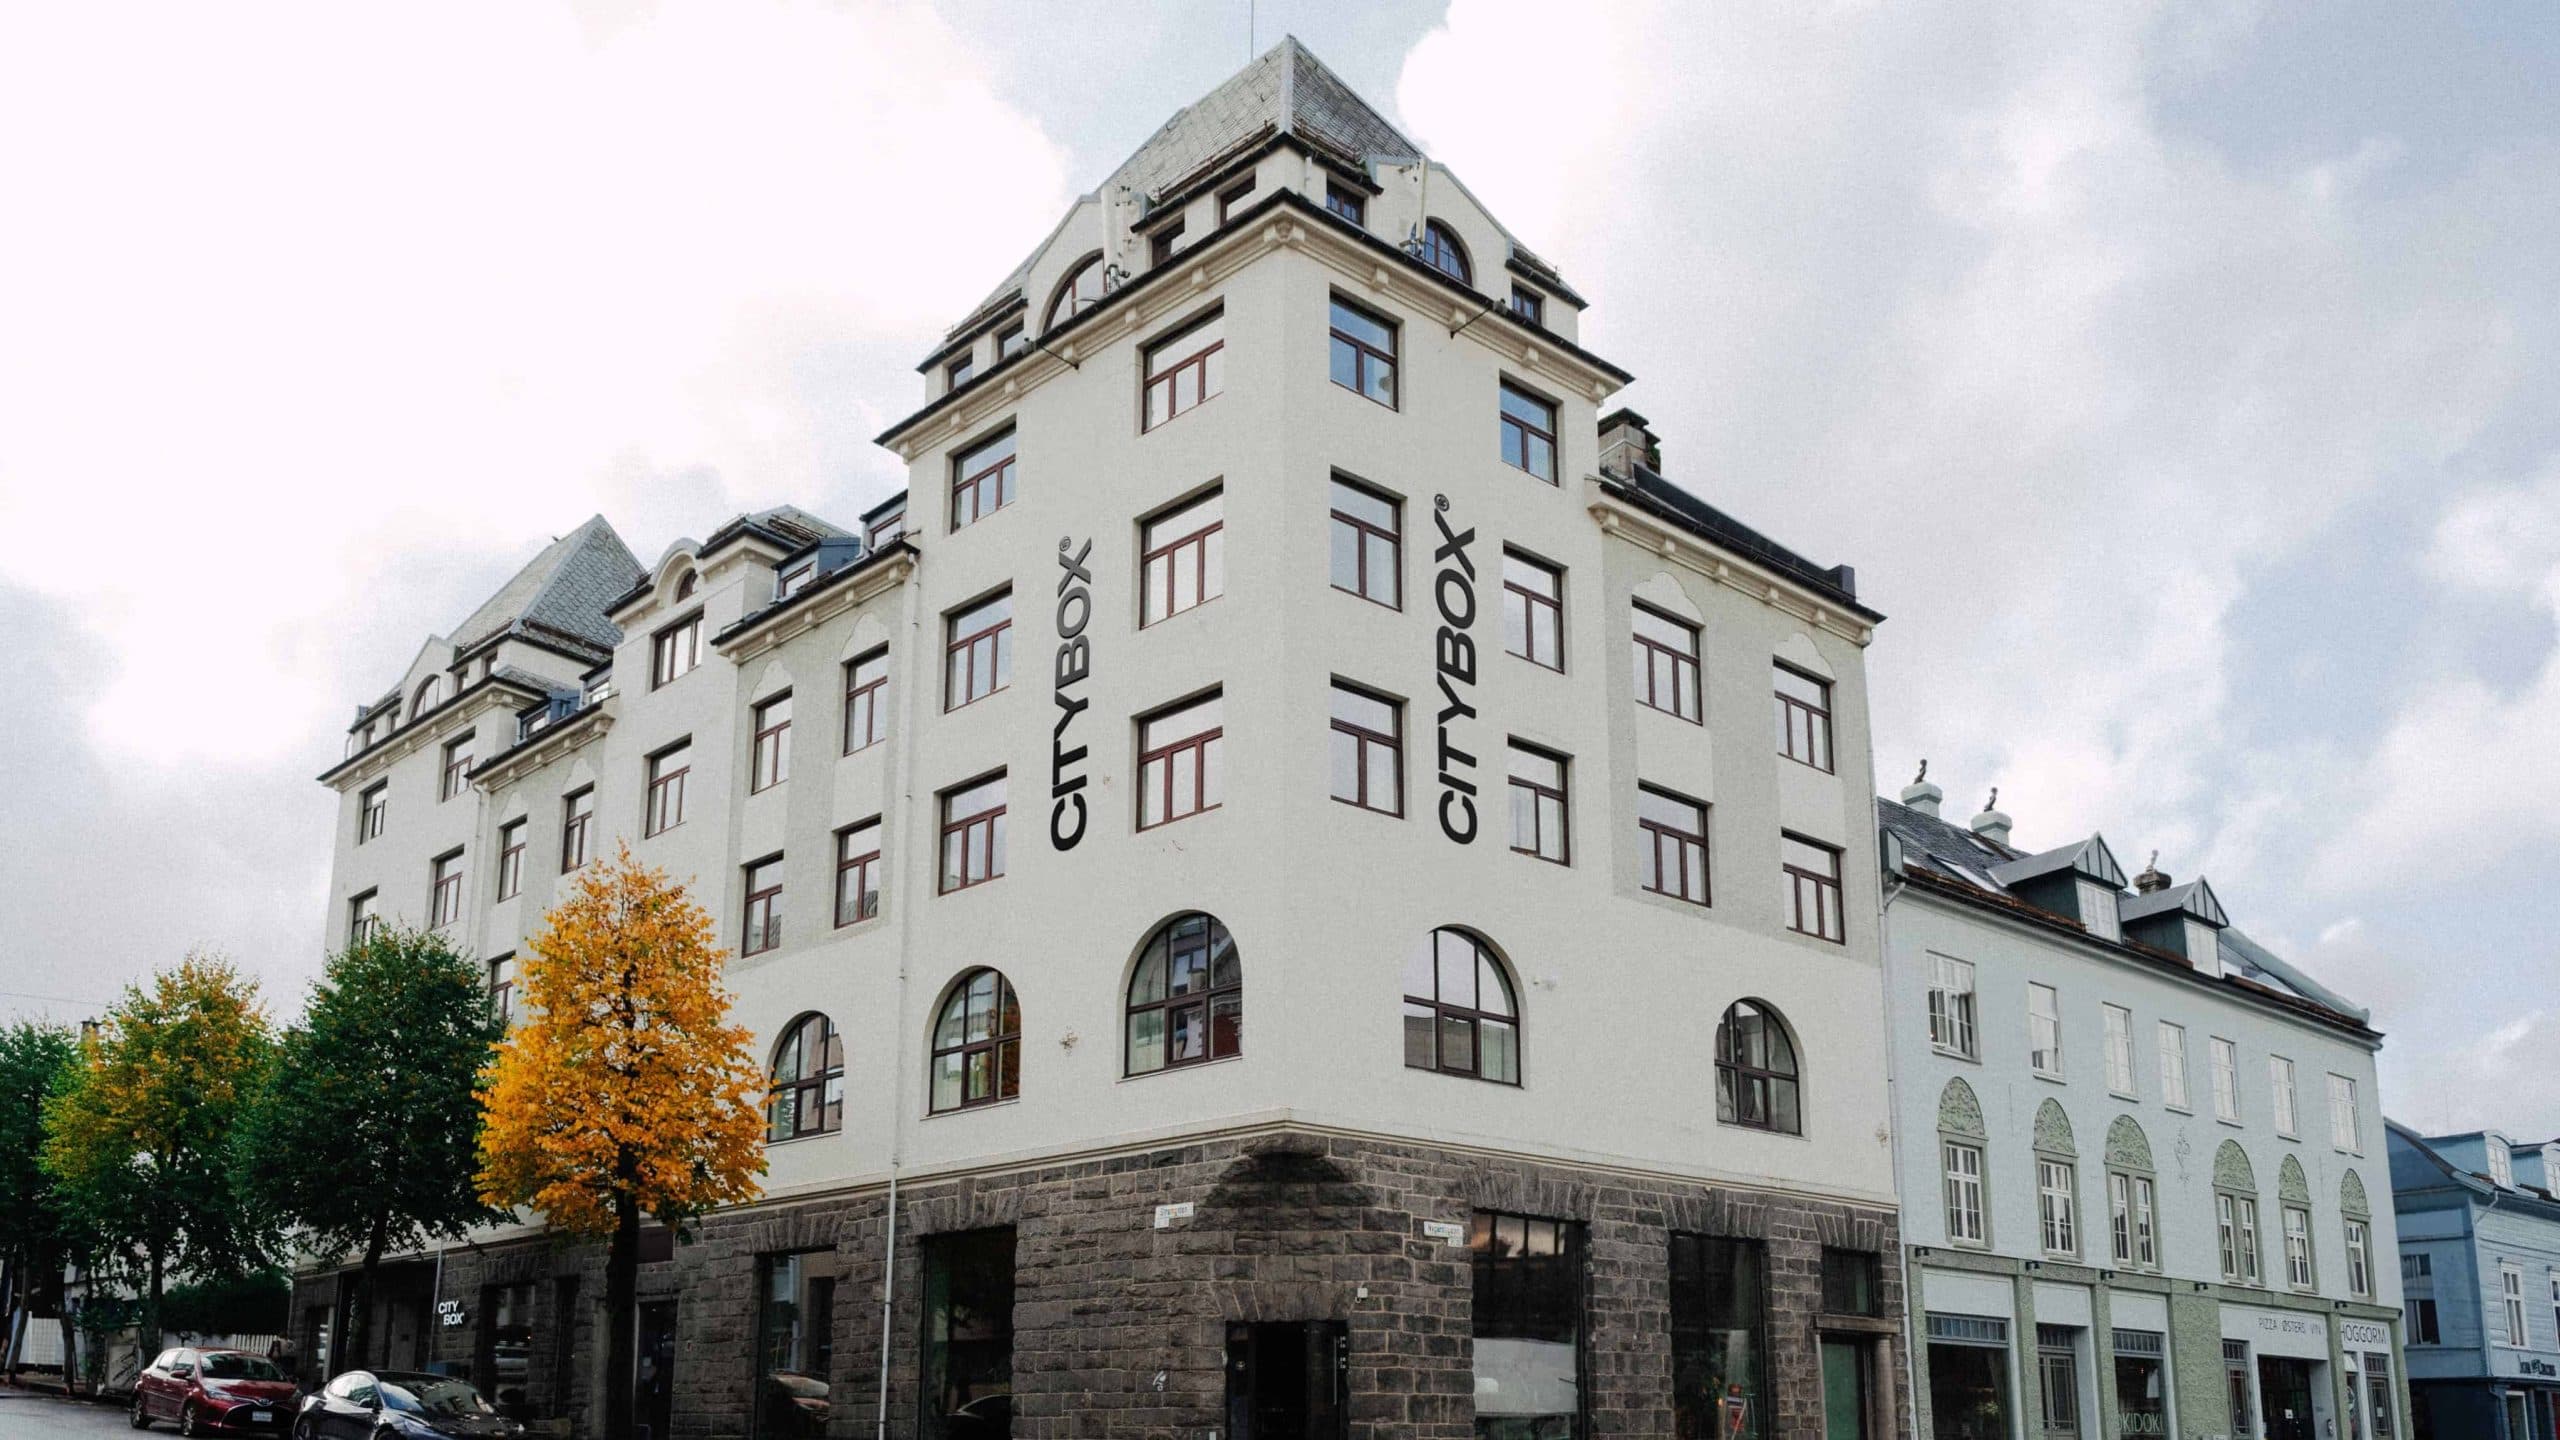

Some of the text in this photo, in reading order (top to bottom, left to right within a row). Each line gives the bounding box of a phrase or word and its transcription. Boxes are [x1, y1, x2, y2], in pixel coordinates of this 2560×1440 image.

[438, 1300, 460, 1314] CITY
[443, 1312, 465, 1326] BOX
[2258, 1317, 2278, 1331] PIZZA
